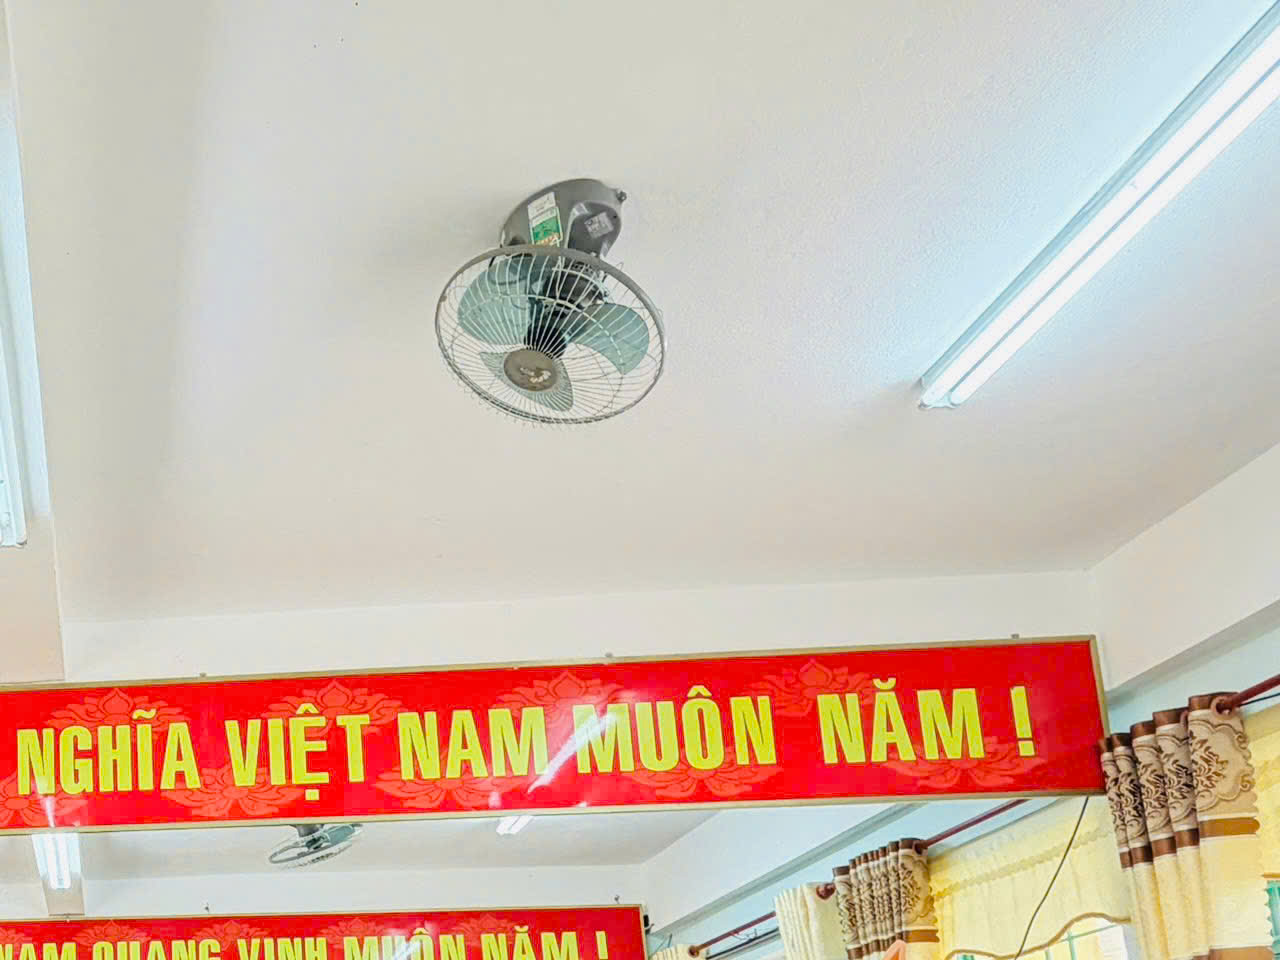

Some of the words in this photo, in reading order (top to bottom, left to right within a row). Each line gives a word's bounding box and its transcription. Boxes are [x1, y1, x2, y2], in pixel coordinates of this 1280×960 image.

[16, 708, 202, 797] NGHĨA
[224, 702, 374, 802] VIỆT
[397, 706, 553, 781] NAM
[573, 685, 778, 774] MUÔN
[816, 677, 986, 765] NĂM
[1010, 685, 1036, 758] !
